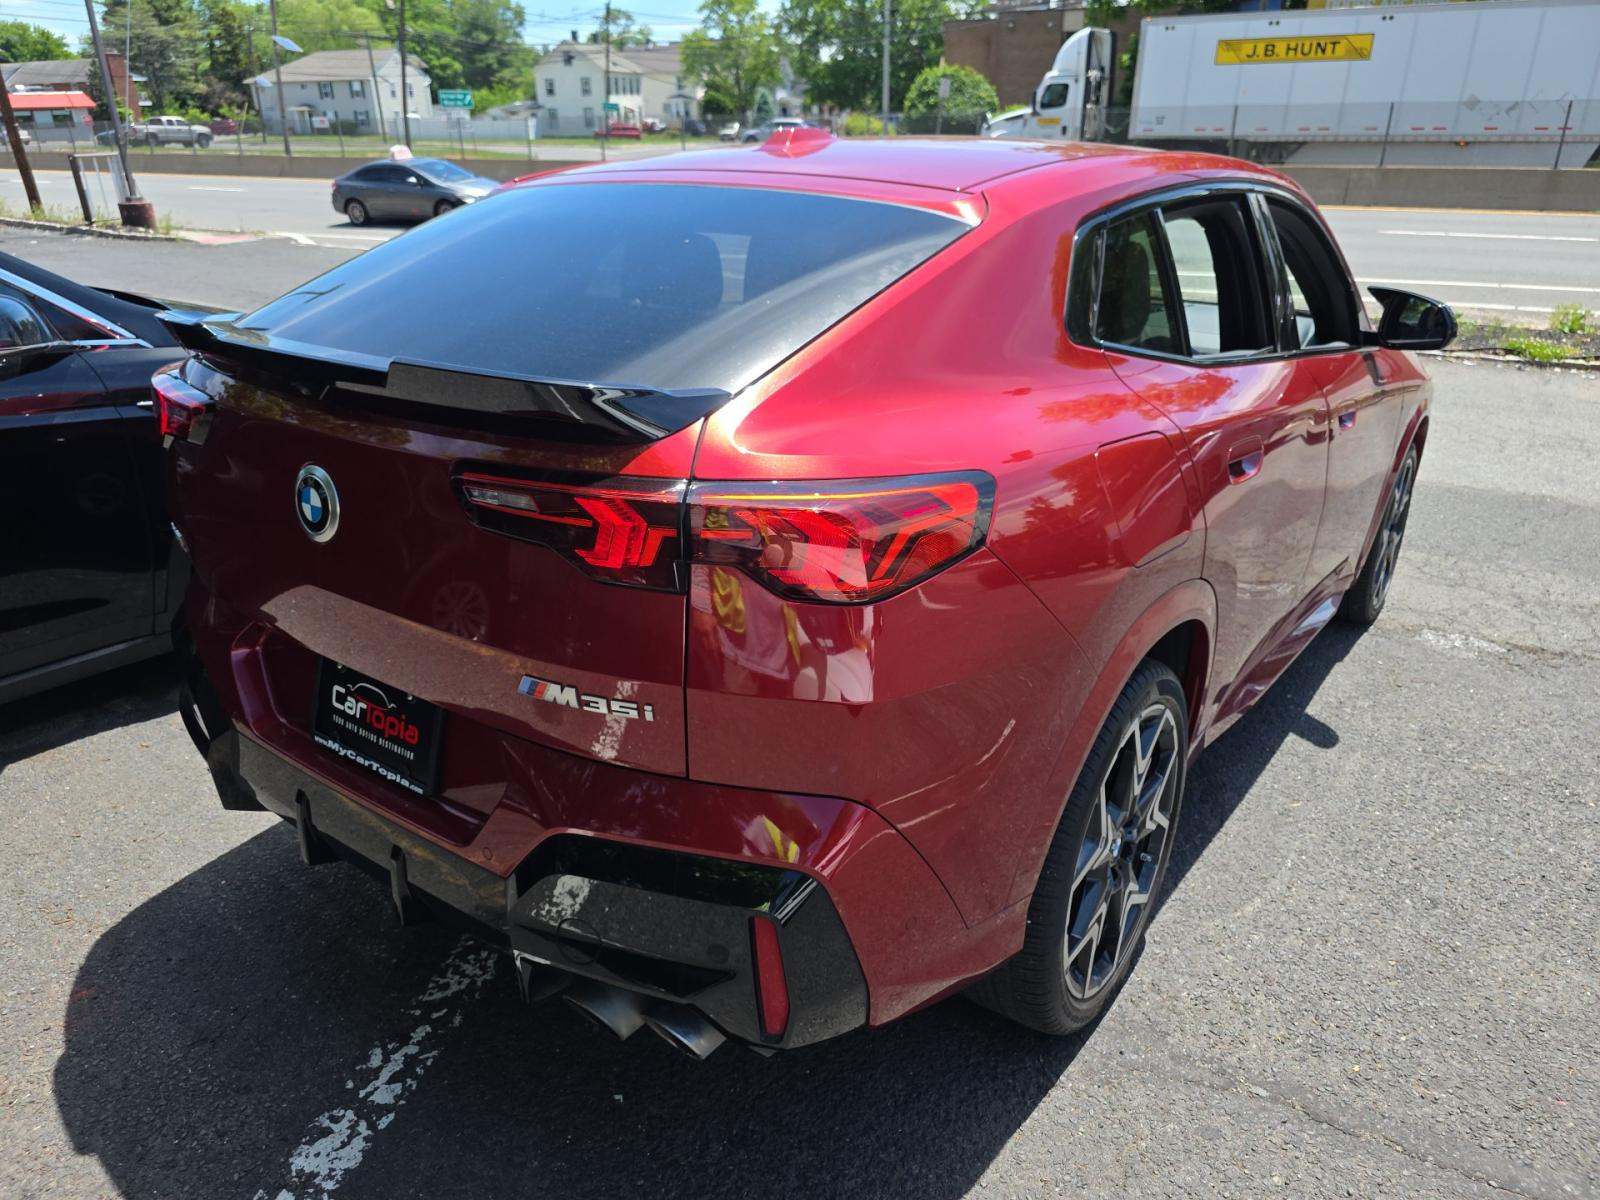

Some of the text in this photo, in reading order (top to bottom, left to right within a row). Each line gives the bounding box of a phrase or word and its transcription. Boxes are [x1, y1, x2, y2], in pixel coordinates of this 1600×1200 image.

[1246, 41, 1341, 58] J.B. HUNT
[543, 682, 654, 721] M35i
